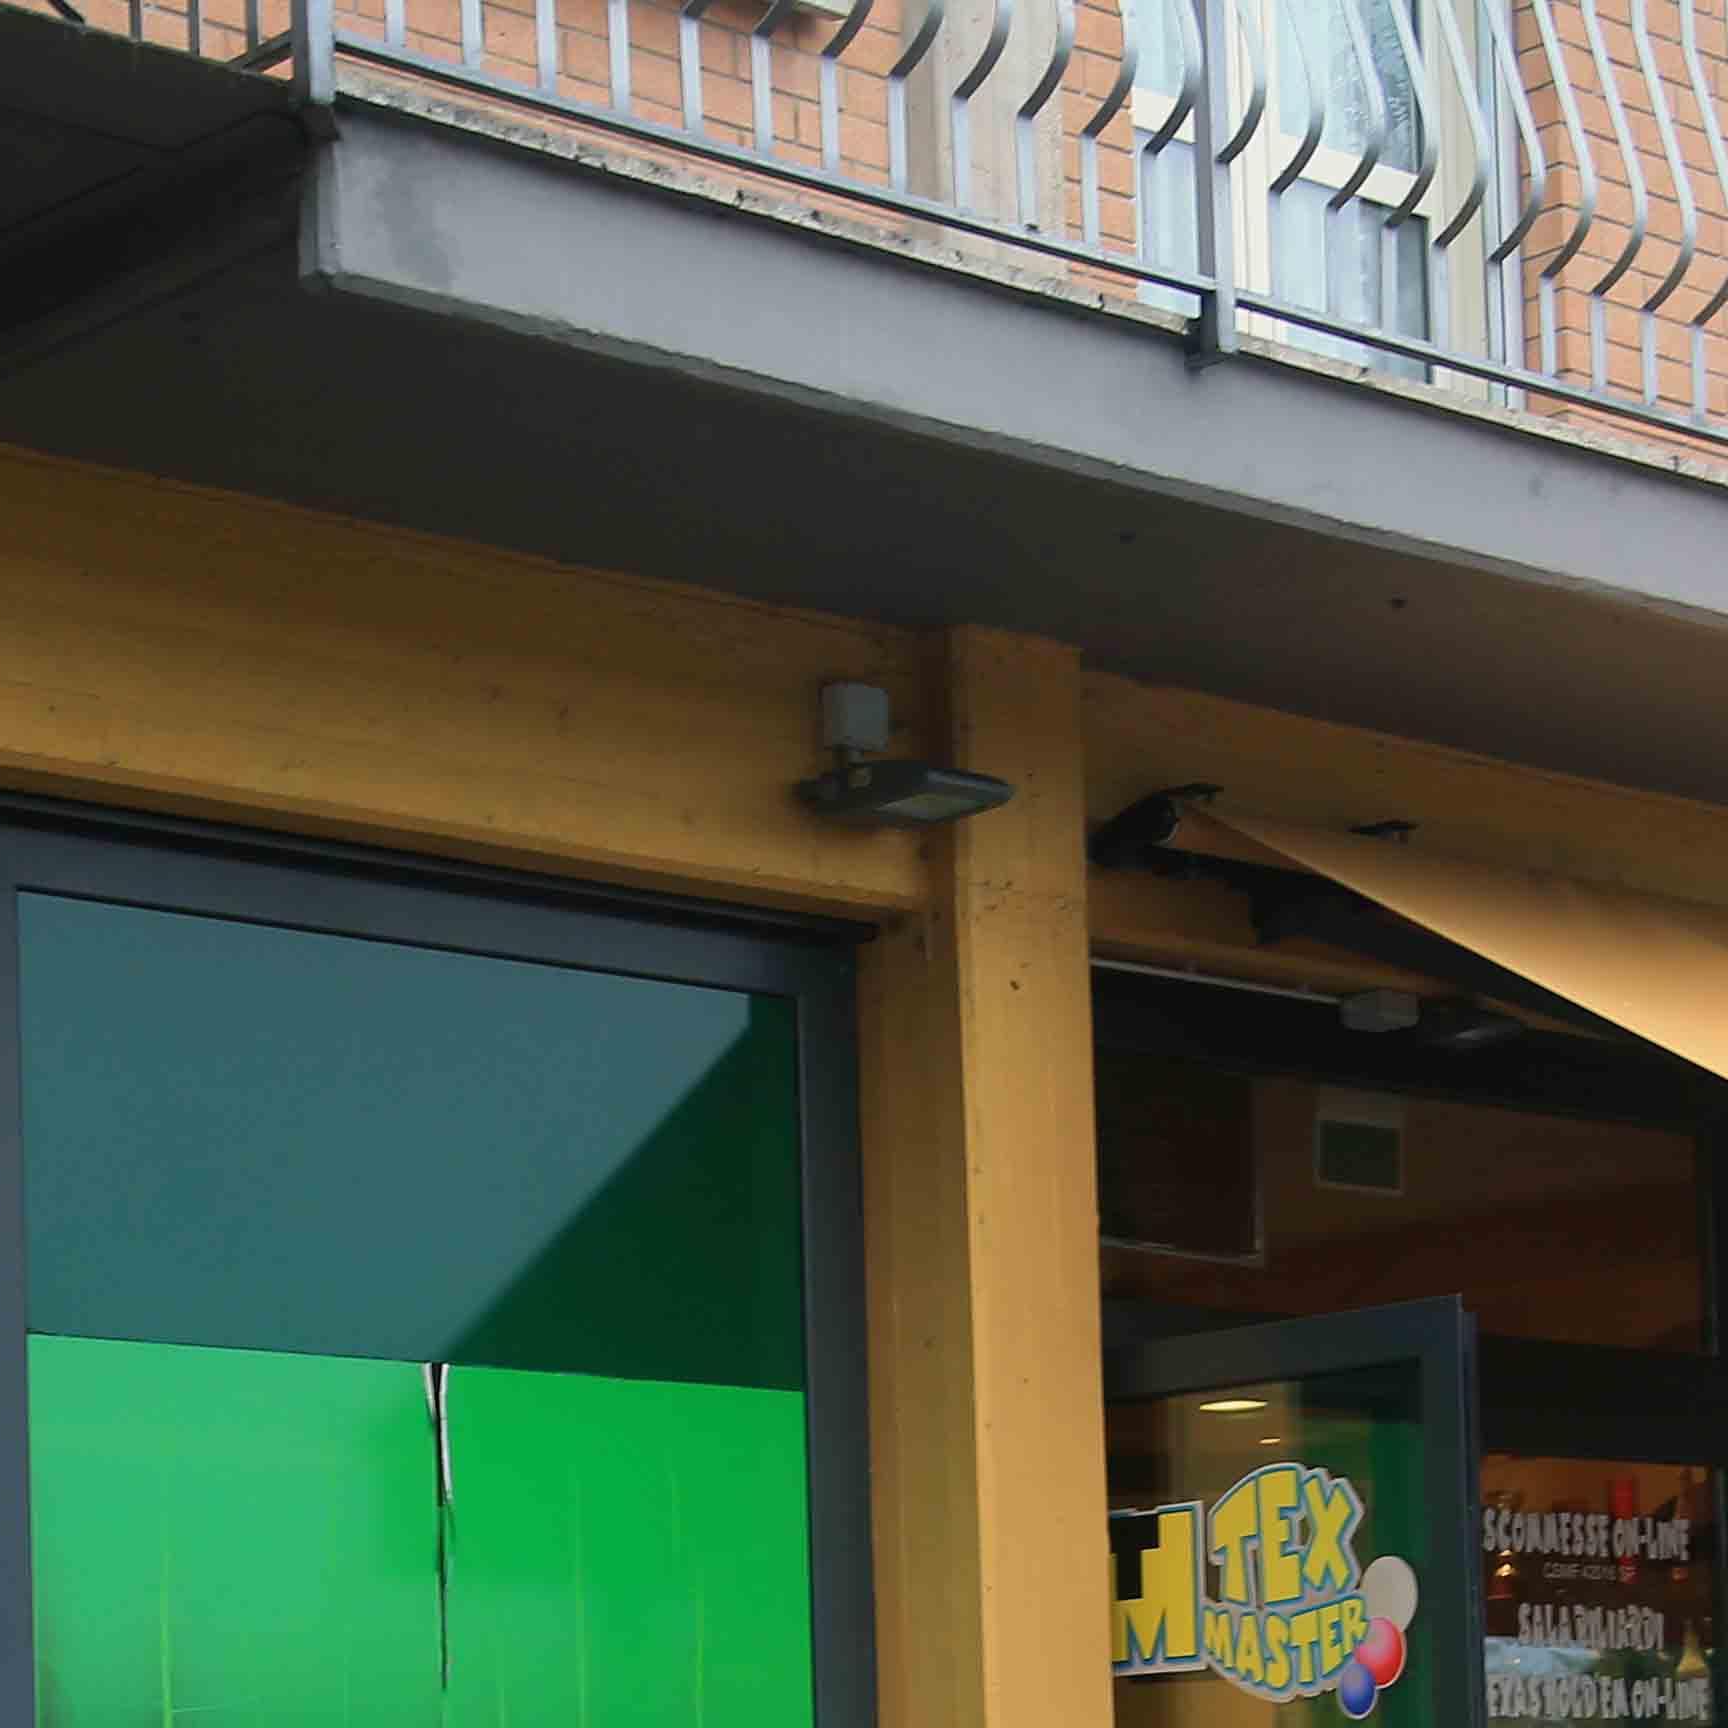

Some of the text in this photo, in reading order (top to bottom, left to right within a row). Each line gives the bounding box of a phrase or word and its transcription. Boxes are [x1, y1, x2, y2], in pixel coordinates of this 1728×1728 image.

[1210, 1467, 1353, 1604] TEX
[1483, 1508, 1690, 1561] SCOMMESSE ON-LINE
[1202, 1598, 1369, 1690] MASTER
[1518, 1602, 1572, 1646] SALA
